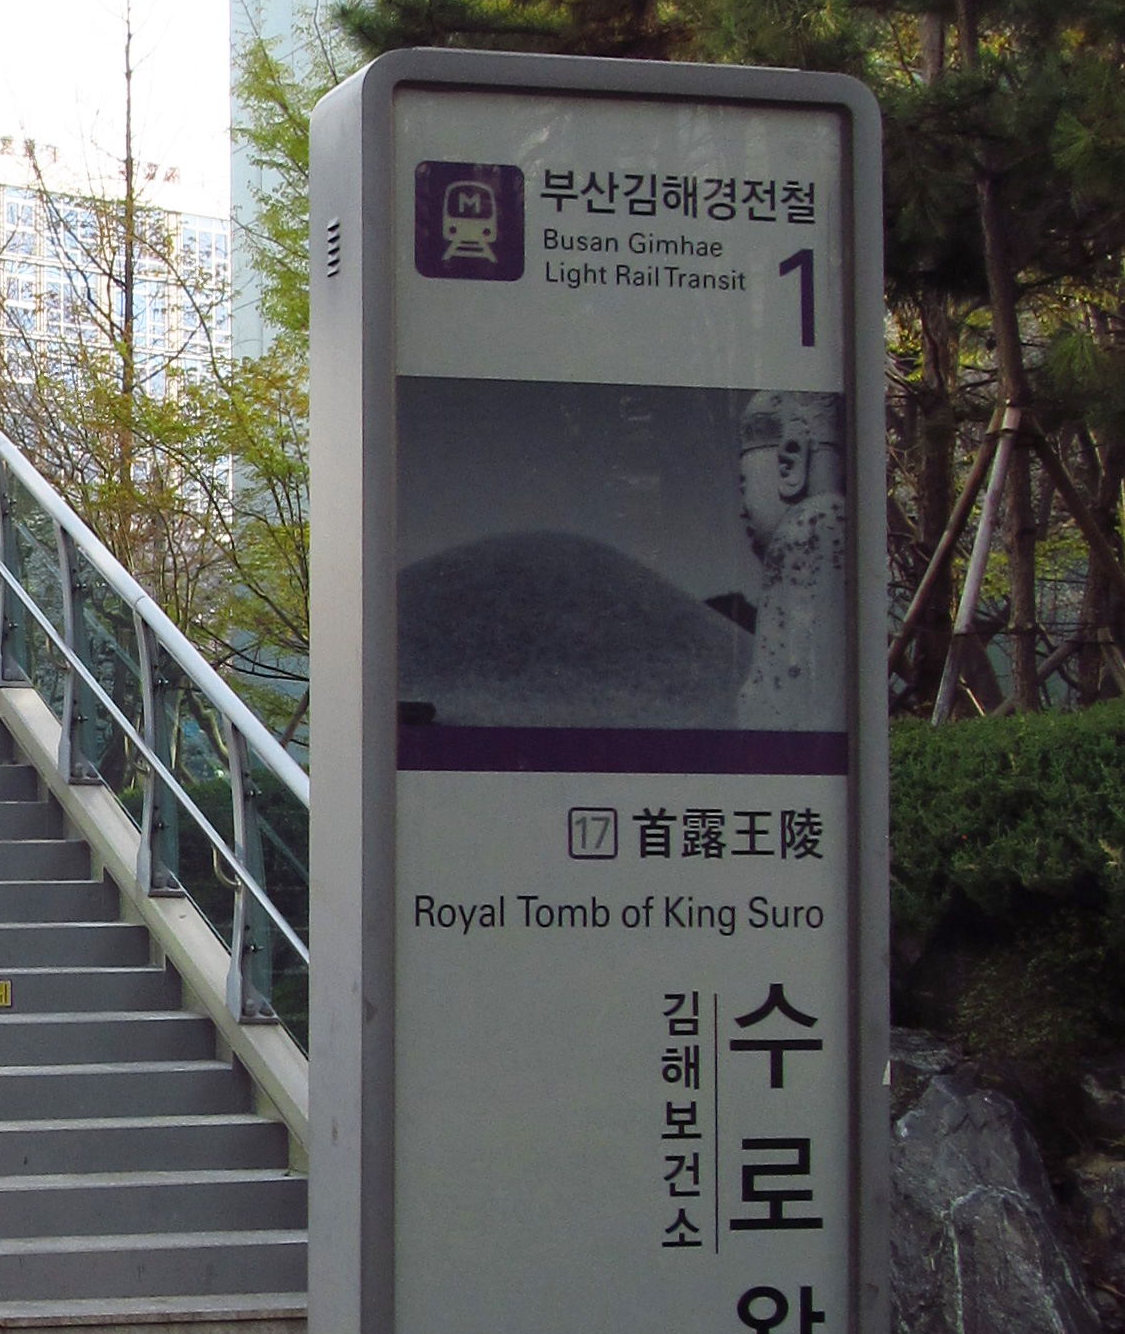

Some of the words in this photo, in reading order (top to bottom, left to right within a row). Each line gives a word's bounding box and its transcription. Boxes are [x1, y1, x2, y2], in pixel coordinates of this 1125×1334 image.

[541, 169, 816, 225] 부산김해경전철
[544, 229, 619, 253] Busan
[629, 233, 724, 258] Gimhae
[546, 262, 607, 290] Light
[617, 265, 660, 287] Rail
[664, 267, 747, 291] Transit
[779, 248, 816, 348] 1
[575, 817, 611, 850] 17
[633, 807, 825, 860] 首露王陵
[415, 895, 506, 935] Royal
[518, 896, 610, 929] Tomb
[622, 896, 655, 929] of
[665, 897, 737, 937] King
[749, 896, 825, 929] Suro
[661, 992, 704, 1249] 김해보건소
